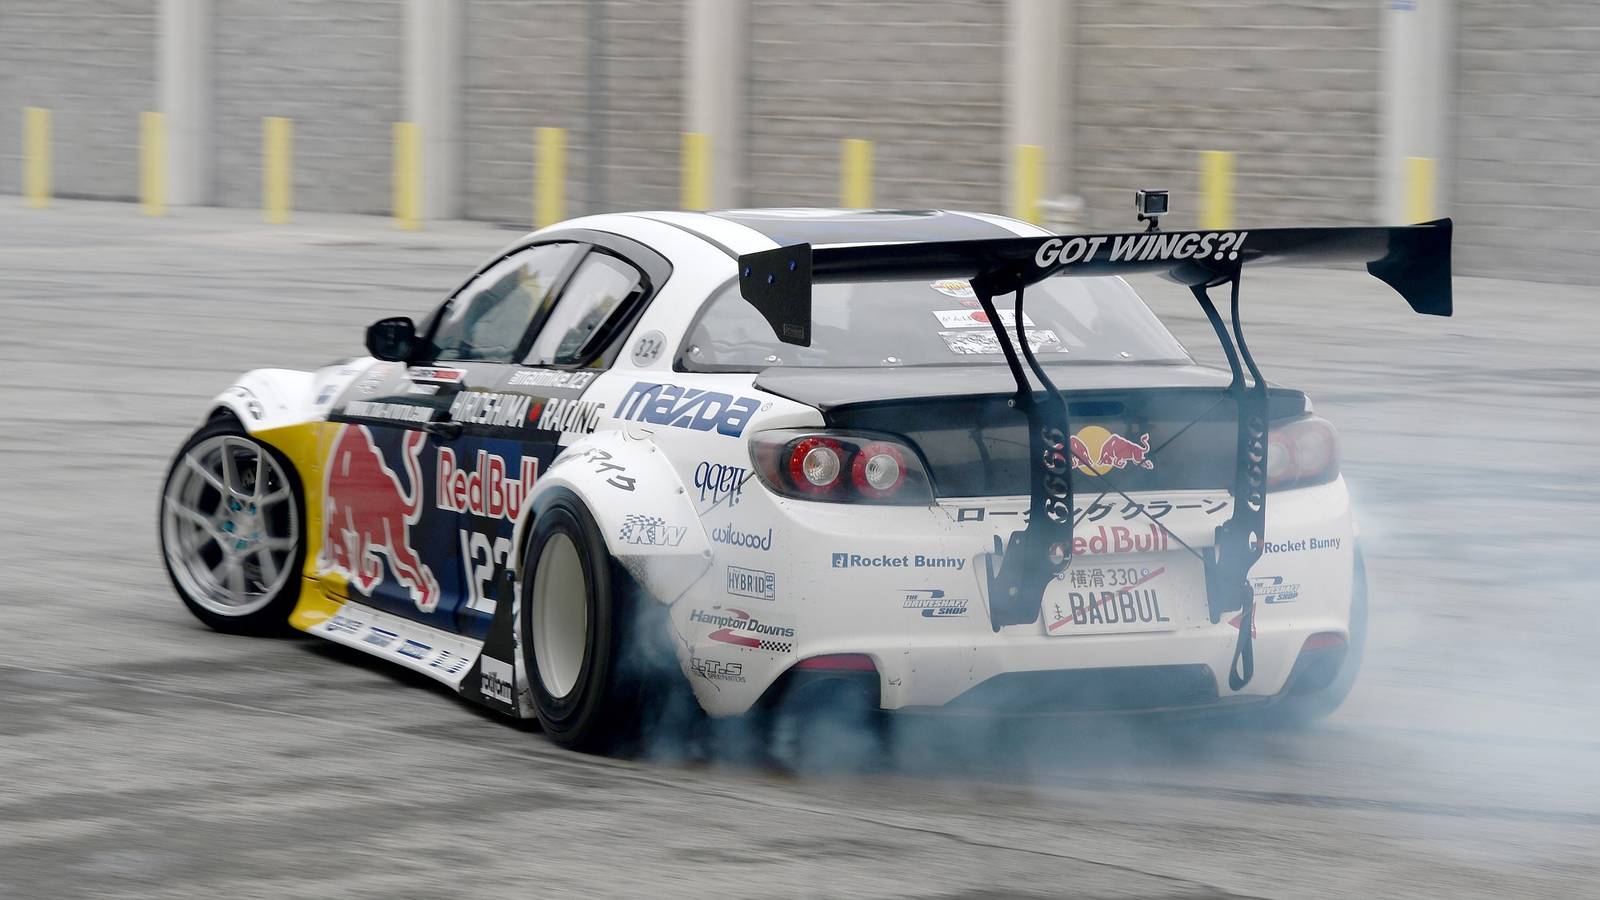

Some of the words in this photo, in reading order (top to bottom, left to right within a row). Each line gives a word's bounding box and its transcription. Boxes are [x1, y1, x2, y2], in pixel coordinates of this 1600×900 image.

[1035, 236, 1107, 268] GOT
[1109, 231, 1248, 262] WINGS?!
[635, 338, 663, 359] 324
[537, 397, 605, 434] RACING
[436, 446, 488, 517] Red
[628, 524, 688, 547] KW
[712, 522, 773, 551] wilwood
[1111, 523, 1168, 553] Bull
[1264, 540, 1307, 554] Rocket
[1310, 537, 1341, 550] Bunny
[850, 554, 909, 568] Rocket
[914, 554, 966, 570] Bunny
[728, 572, 765, 594] HYBRID
[765, 574, 774, 599] LAB
[1107, 567, 1138, 587] 330
[903, 599, 968, 609] DRIVESHAFT
[938, 607, 967, 615] SHOP
[1068, 589, 1170, 625] BADBUL
[690, 608, 747, 631] Hampton
[747, 618, 795, 638] Downs
